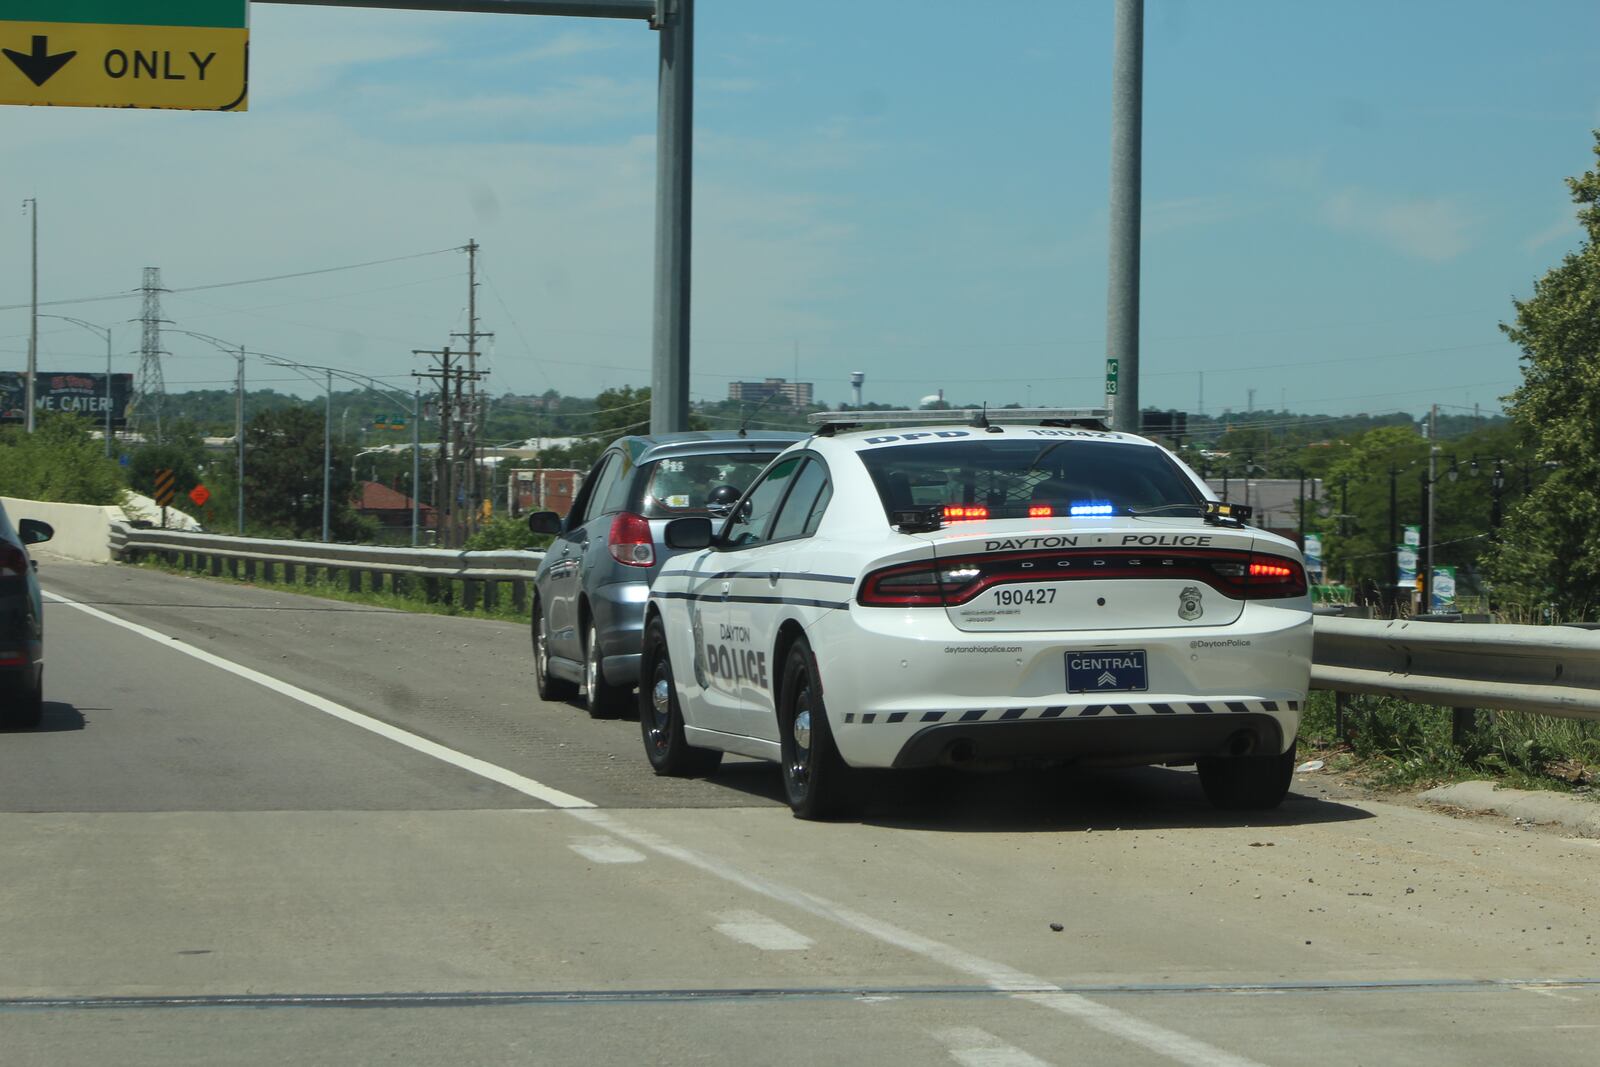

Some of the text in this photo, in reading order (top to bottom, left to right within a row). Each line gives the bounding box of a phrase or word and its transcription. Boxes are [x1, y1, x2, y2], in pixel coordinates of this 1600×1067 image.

[104, 49, 217, 80] ONLY
[863, 430, 971, 445] DPD
[1028, 428, 1124, 440] 190427
[985, 535, 1213, 551] DAYTON POLICE
[1021, 559, 1174, 568] DODGE
[994, 588, 1057, 606] 190427
[720, 623, 751, 642] DAYTON
[943, 645, 1022, 655] daytonohiopolice.com
[1190, 639, 1251, 649] @DaytonPolice
[706, 643, 769, 690] POLICE
[1071, 658, 1142, 670] CENTRAL
